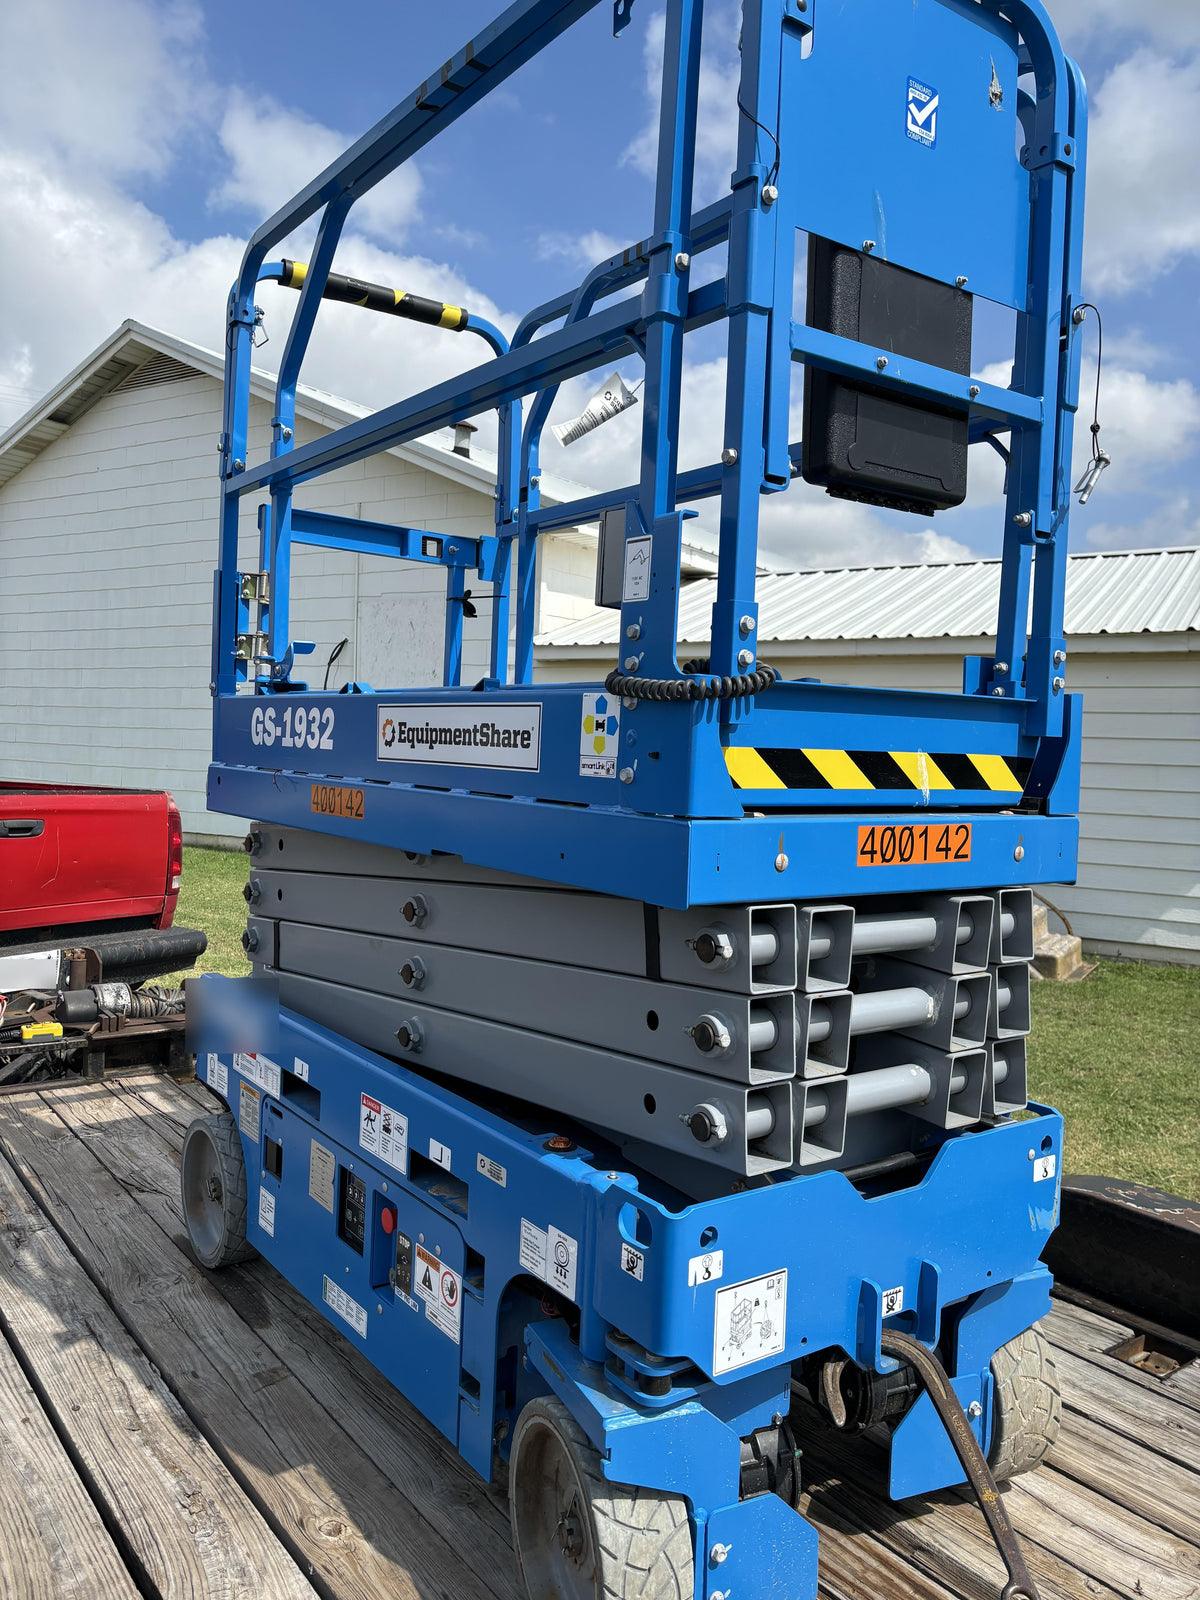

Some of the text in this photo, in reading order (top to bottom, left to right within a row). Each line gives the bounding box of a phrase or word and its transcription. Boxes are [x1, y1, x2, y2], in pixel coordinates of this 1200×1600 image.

[909, 79, 932, 97] STANDARD
[907, 130, 932, 148] COMPLIANT
[251, 706, 335, 750] GS-1932
[312, 785, 364, 818] 400142
[860, 824, 970, 864] 400142
